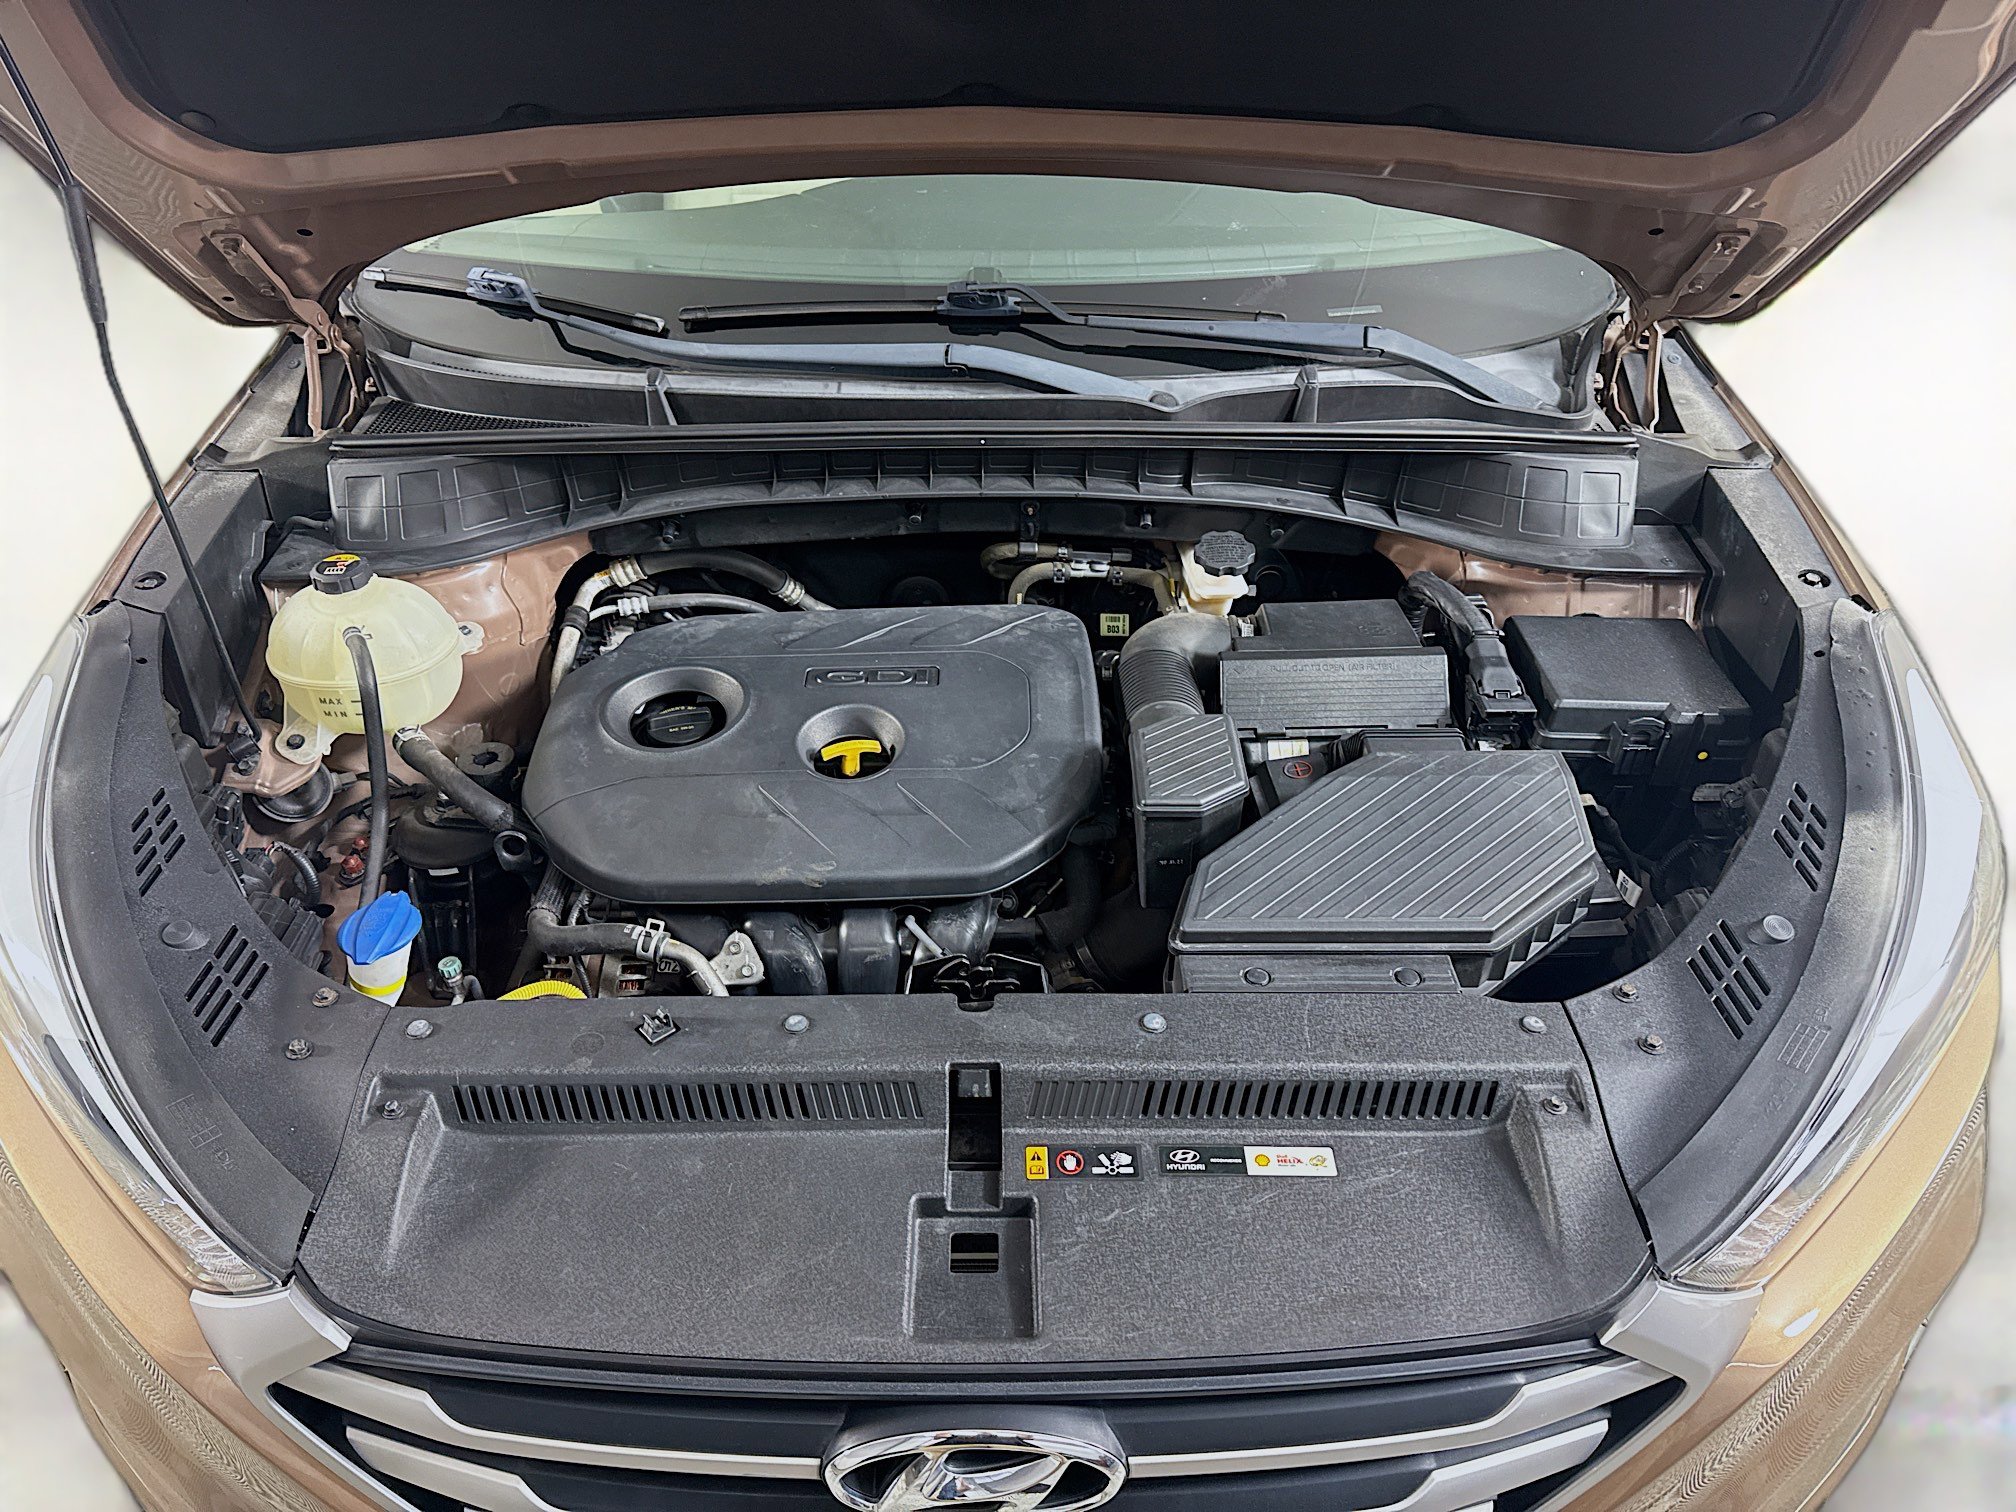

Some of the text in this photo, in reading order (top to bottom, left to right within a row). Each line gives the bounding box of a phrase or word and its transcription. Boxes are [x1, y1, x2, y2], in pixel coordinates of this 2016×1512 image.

[1321, 663, 1345, 671] OPEN
[817, 671, 928, 685] GDI
[319, 697, 342, 705] MAX
[1166, 1163, 1206, 1171] HYUNDAI
